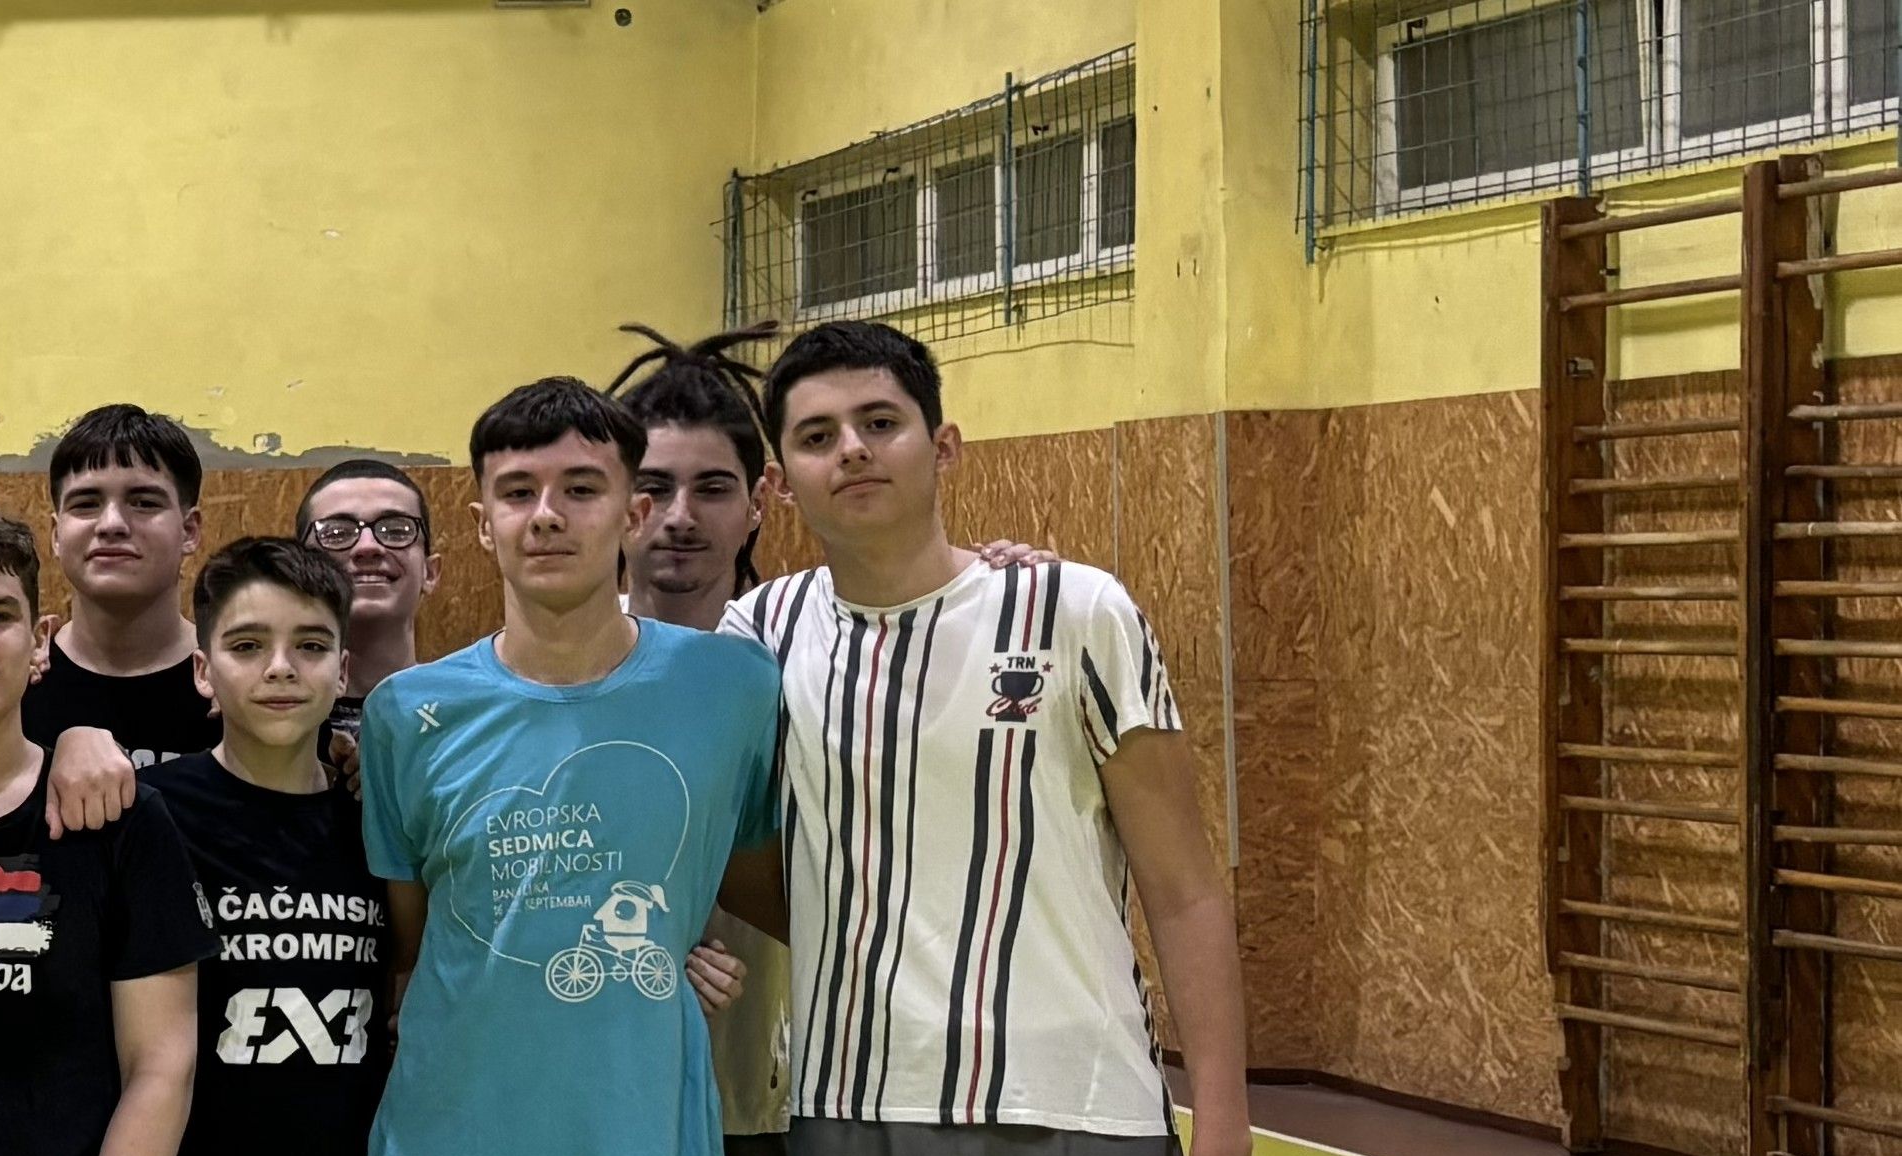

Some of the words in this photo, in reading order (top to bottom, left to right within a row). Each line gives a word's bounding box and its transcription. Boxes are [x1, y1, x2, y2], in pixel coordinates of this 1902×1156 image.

[1007, 656, 1036, 669] TRN
[486, 803, 602, 835] EVROPSKA
[488, 829, 594, 858] SEDMICA
[491, 851, 622, 881] MOBILNOSTI
[220, 932, 378, 963] KROMPIR
